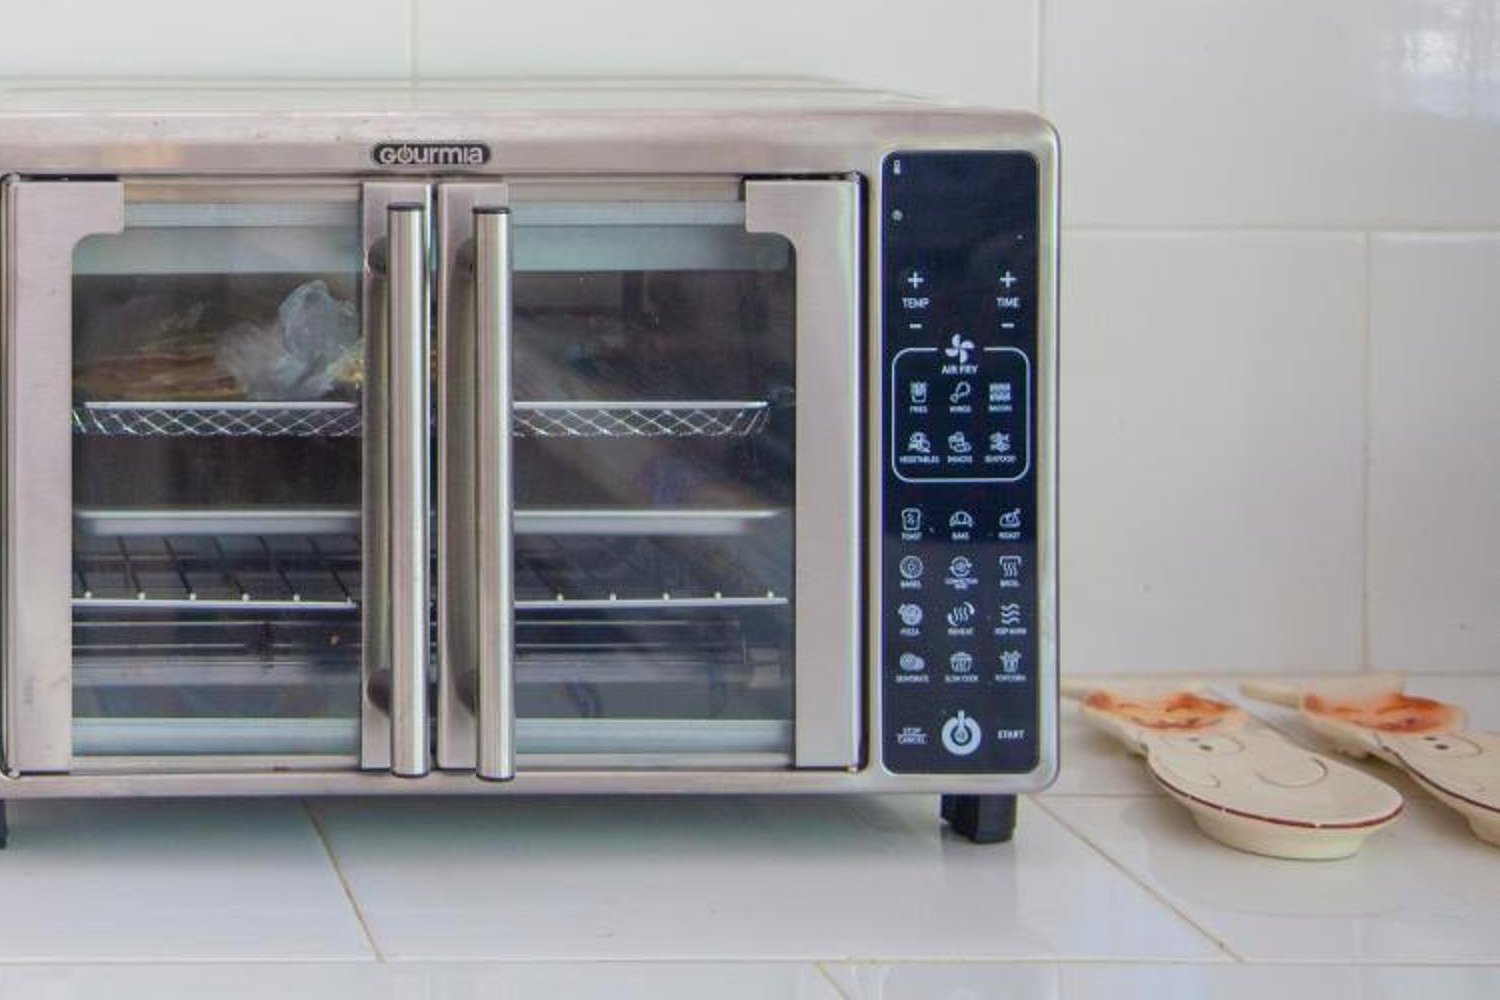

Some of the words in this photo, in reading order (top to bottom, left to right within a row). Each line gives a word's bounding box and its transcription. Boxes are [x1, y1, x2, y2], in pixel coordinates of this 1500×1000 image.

[380, 144, 483, 164] Gourmia
[902, 298, 929, 308] TEMP
[996, 298, 1020, 308] TIME
[941, 365, 958, 375] AIR
[960, 365, 978, 375] FRY
[997, 730, 1025, 739] START
